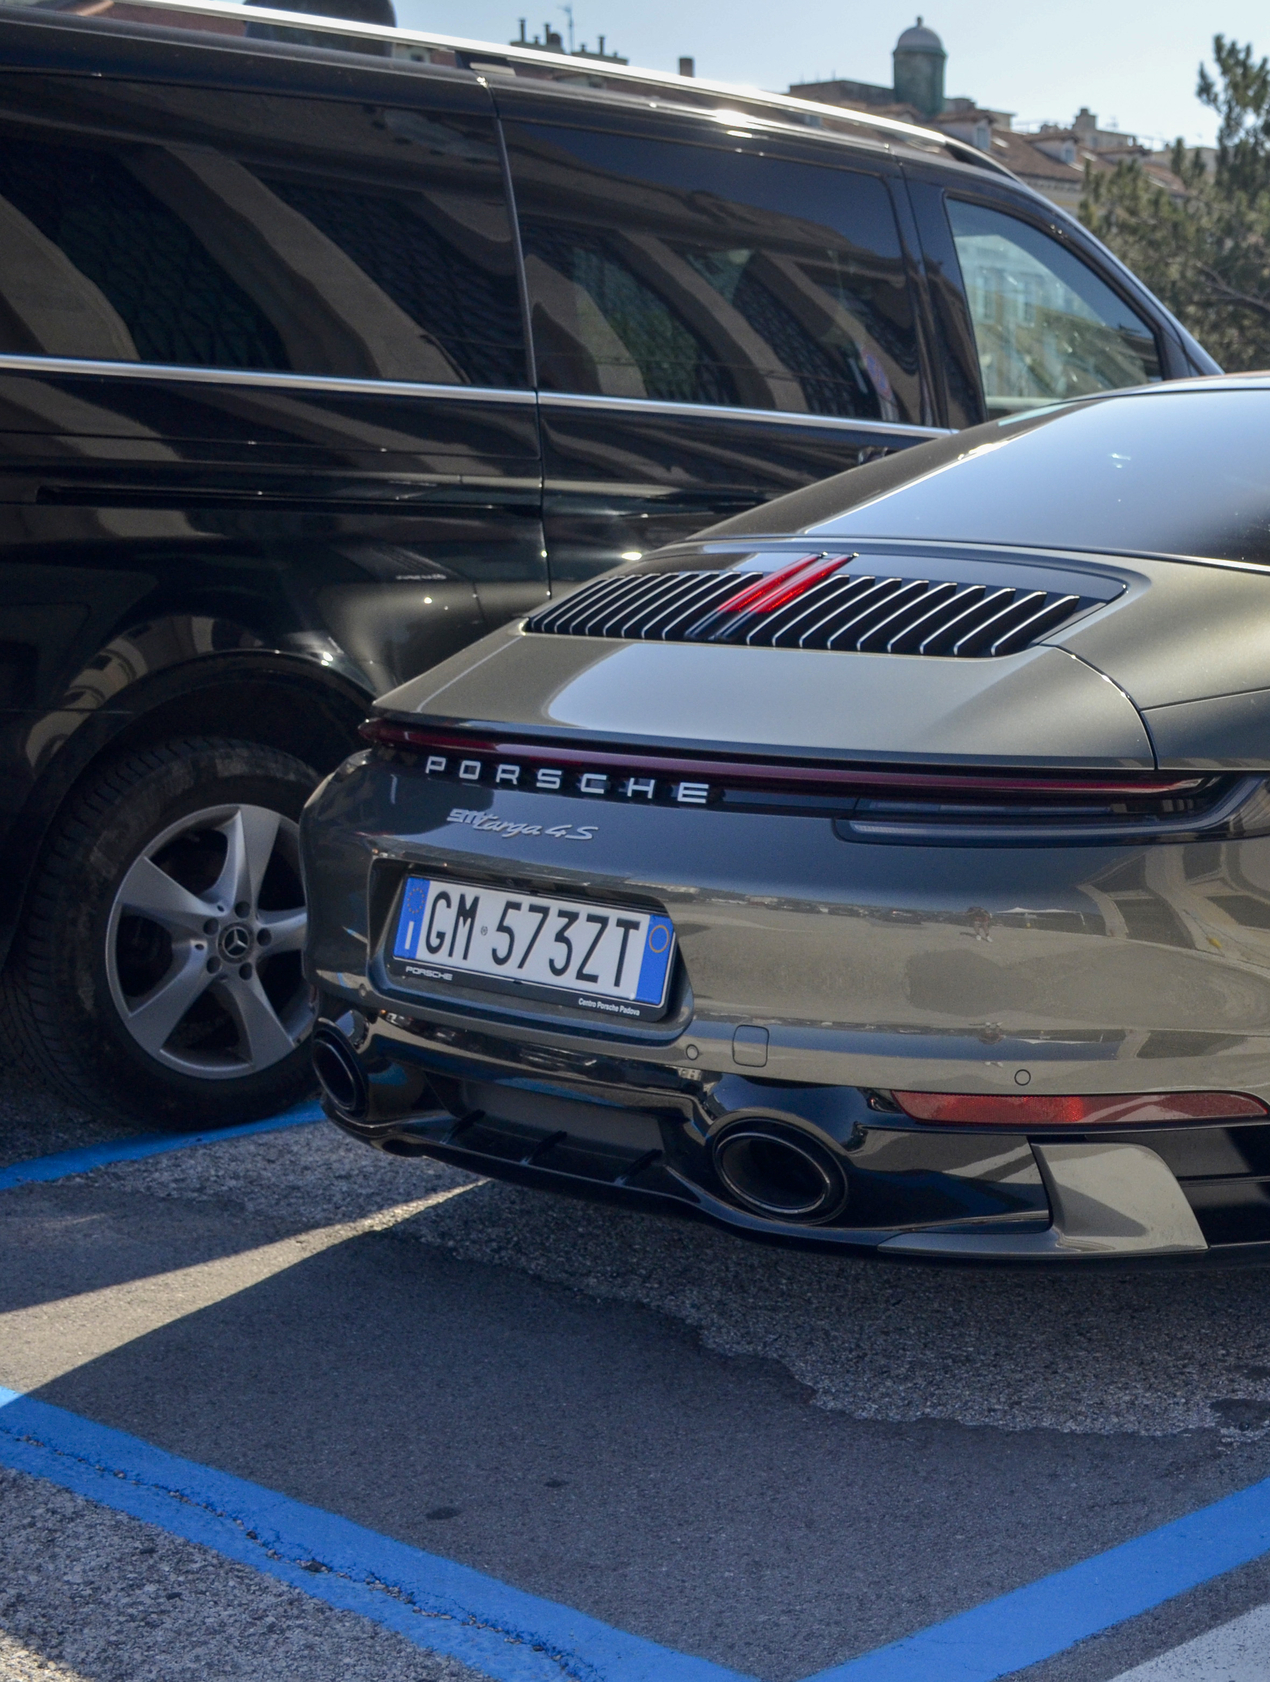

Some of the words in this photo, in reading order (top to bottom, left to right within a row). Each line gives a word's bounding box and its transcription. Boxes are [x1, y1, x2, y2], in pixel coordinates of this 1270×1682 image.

[425, 756, 709, 803] PORSCHE
[545, 825, 598, 840] 4S
[405, 966, 453, 980] PORSCHE
[578, 997, 597, 1008] Centro
[596, 1001, 619, 1012] Porsche
[619, 1005, 640, 1016] Padova
